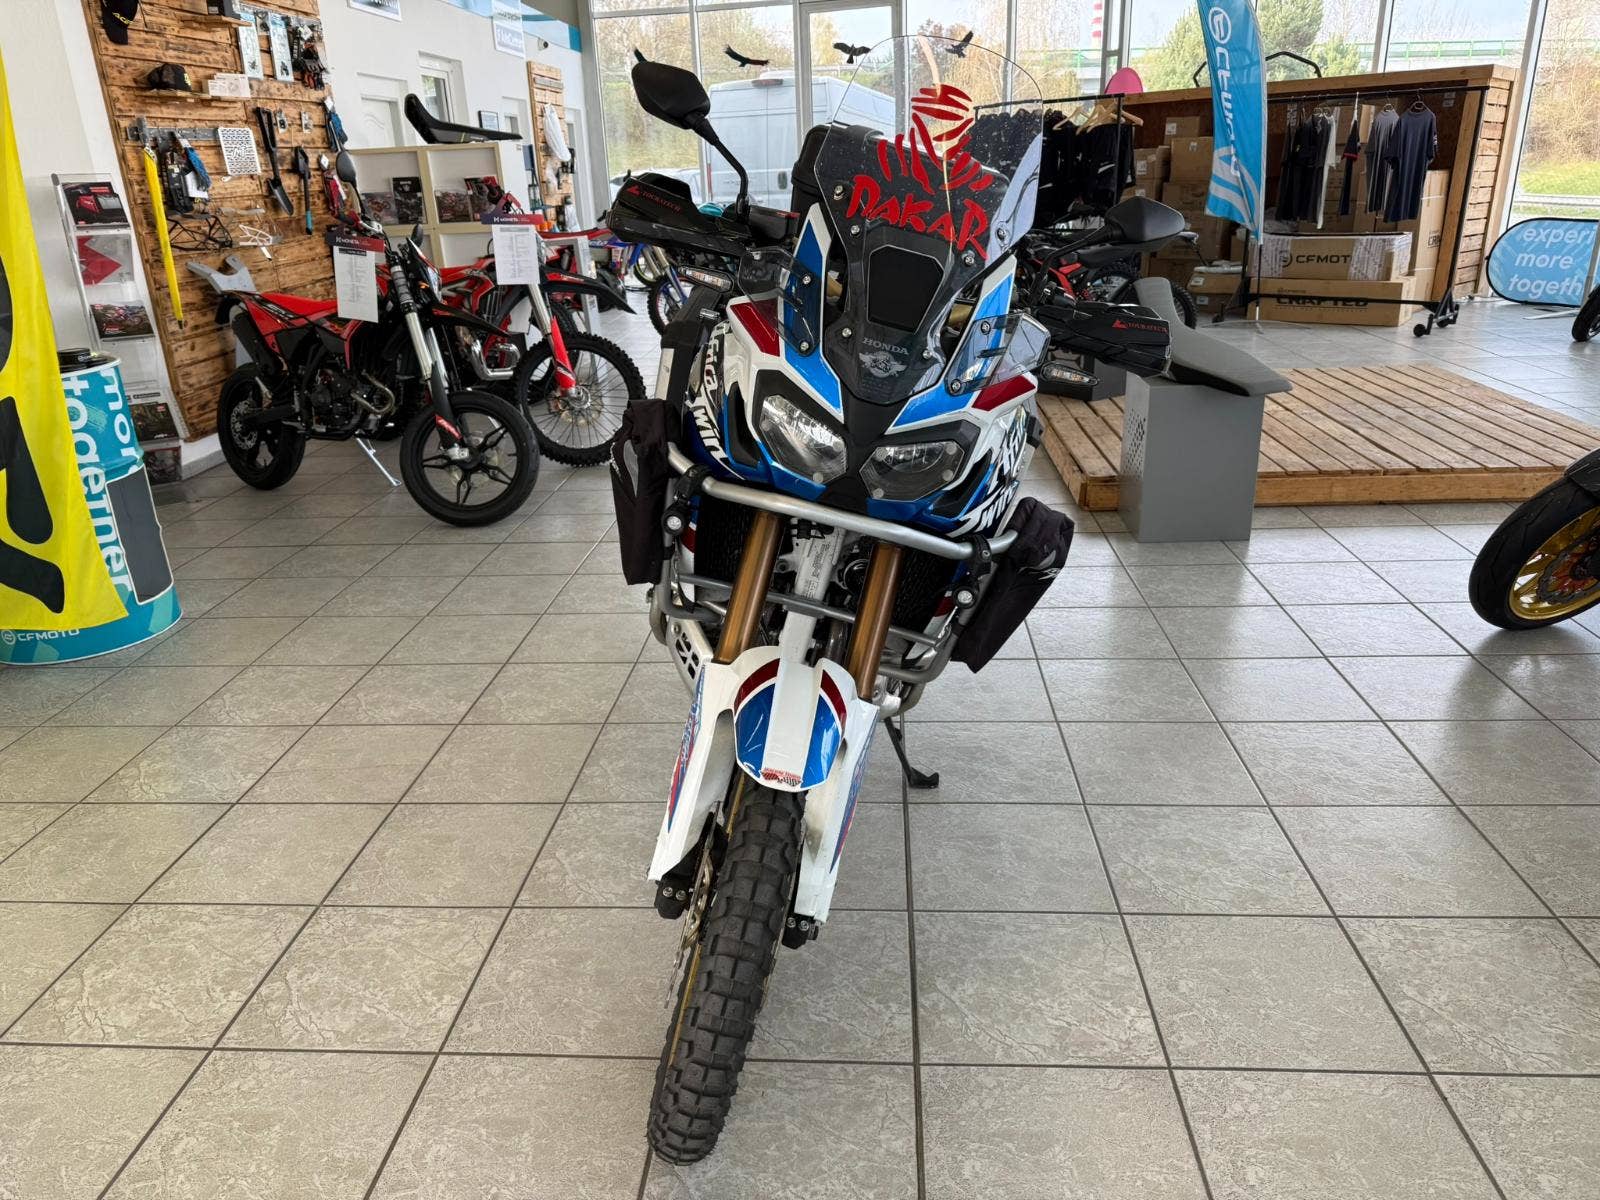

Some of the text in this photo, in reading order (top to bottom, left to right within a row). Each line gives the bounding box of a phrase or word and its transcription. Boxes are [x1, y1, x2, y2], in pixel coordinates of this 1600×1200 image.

[845, 173, 989, 260] DAKAR
[1295, 254, 1352, 264] CFMOT
[1514, 252, 1575, 269] more
[862, 337, 910, 356] HONDA
[100, 368, 140, 475] mor
